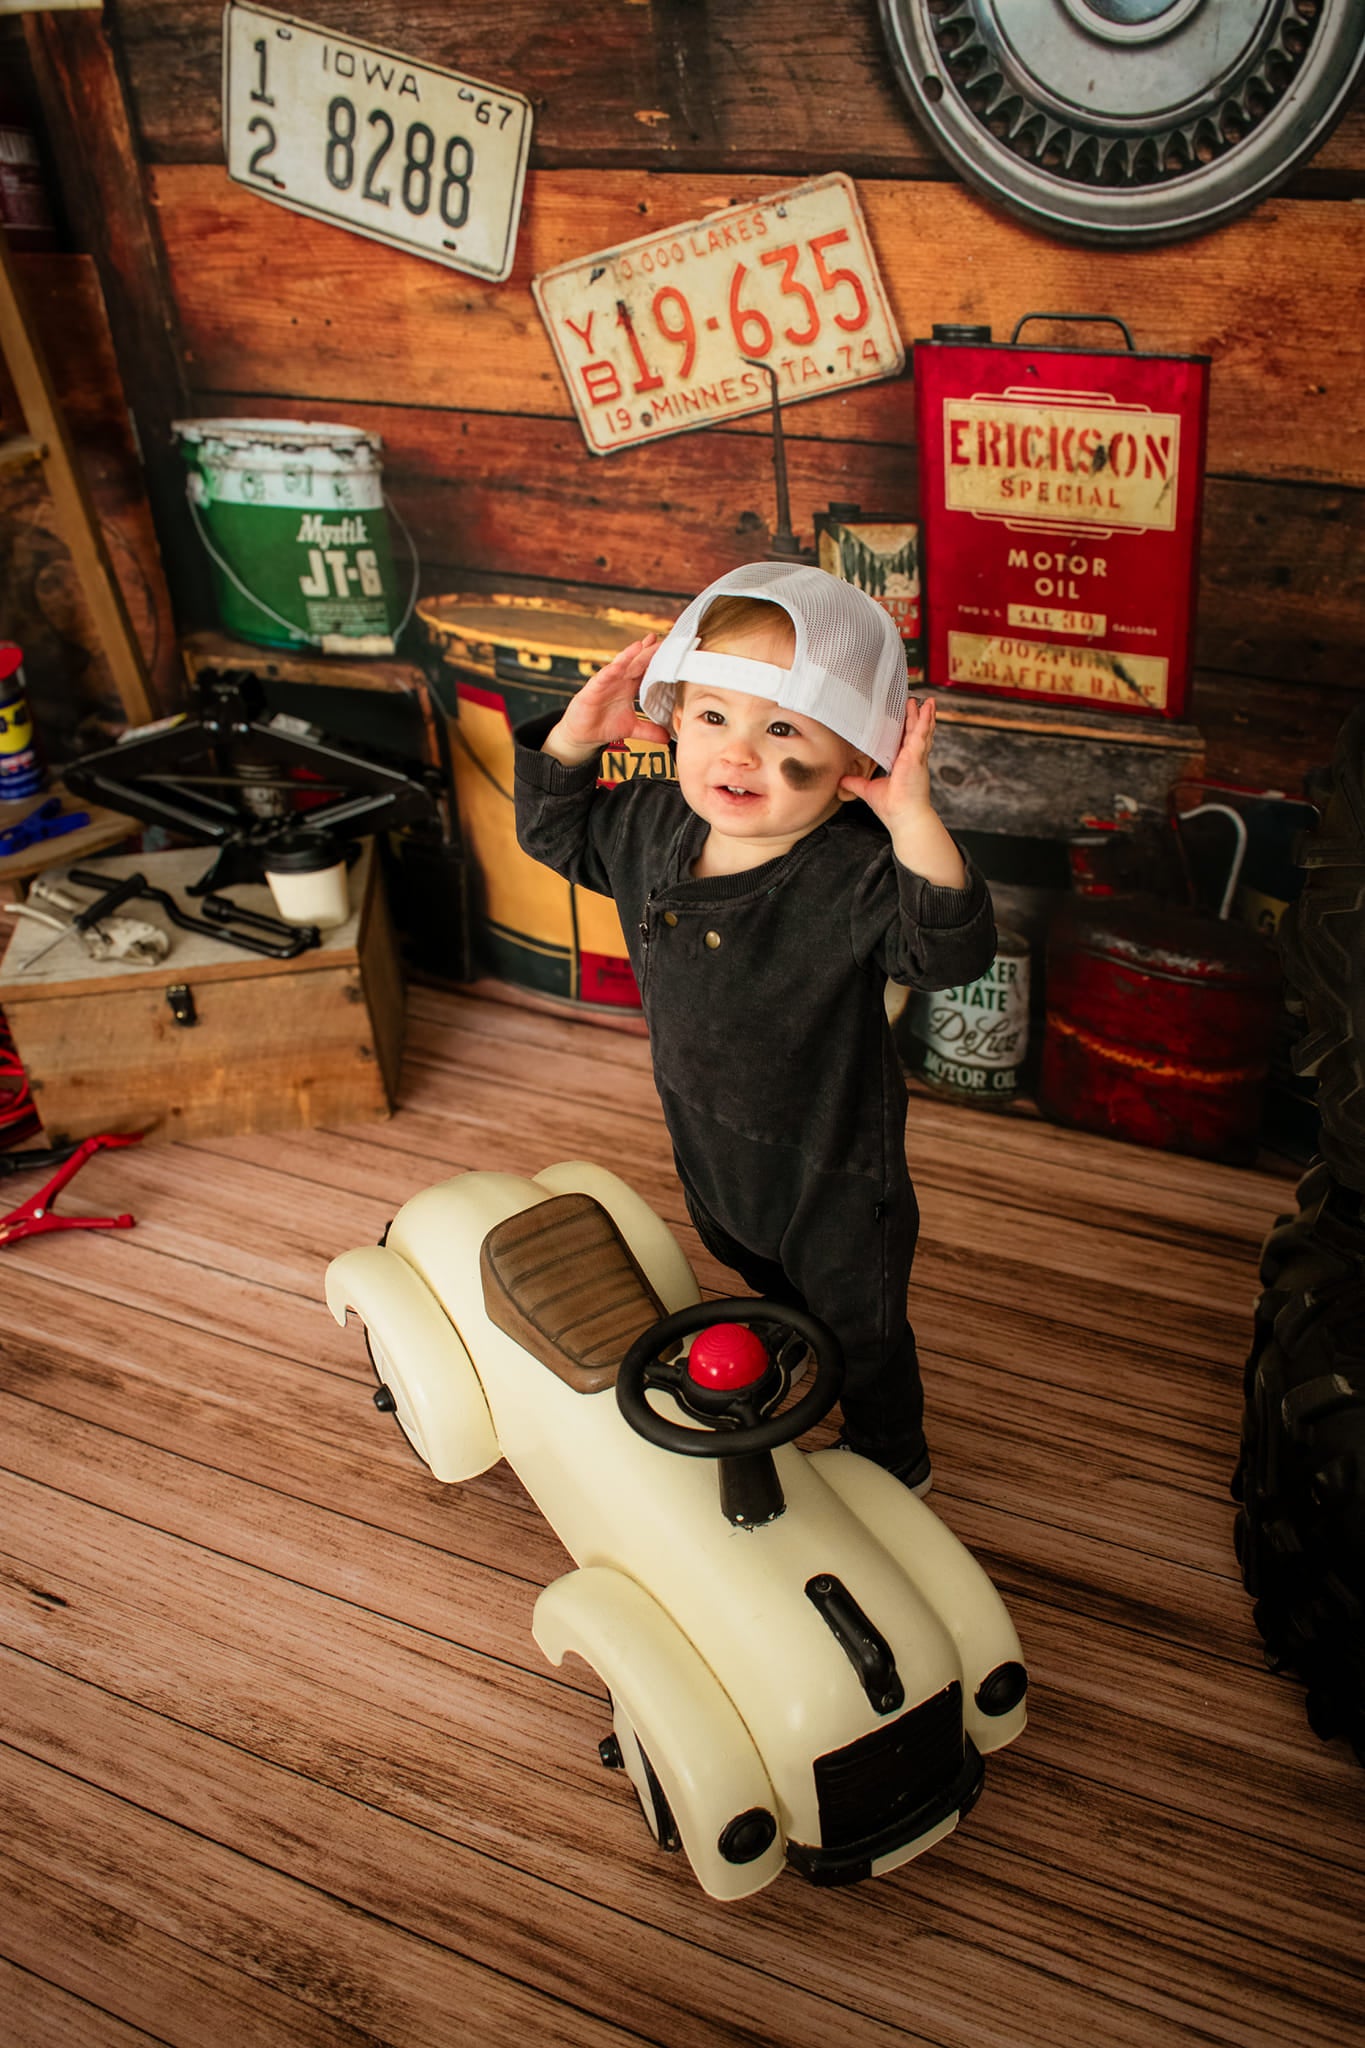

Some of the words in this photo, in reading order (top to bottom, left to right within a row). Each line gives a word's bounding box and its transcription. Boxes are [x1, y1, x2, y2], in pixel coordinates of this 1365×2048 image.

[322, 44, 421, 102] IOWA
[475, 101, 513, 130] 67
[325, 95, 474, 229] 8288
[689, 213, 768, 258] LAKES
[604, 408, 632, 434] 19
[651, 356, 822, 422] MINNESOTA
[837, 339, 880, 370] 74
[950, 420, 1171, 481] ERICKSON
[1000, 478, 1121, 509] SPECIAL
[296, 514, 368, 550] Mystik
[300, 550, 384, 597] JT-6
[1008, 549, 1108, 577] MOTOR
[1035, 577, 1080, 599] OIL
[1062, 612, 1095, 631] 30
[925, 1050, 987, 1089] MOTOR
[992, 1070, 1017, 1090] OIL
